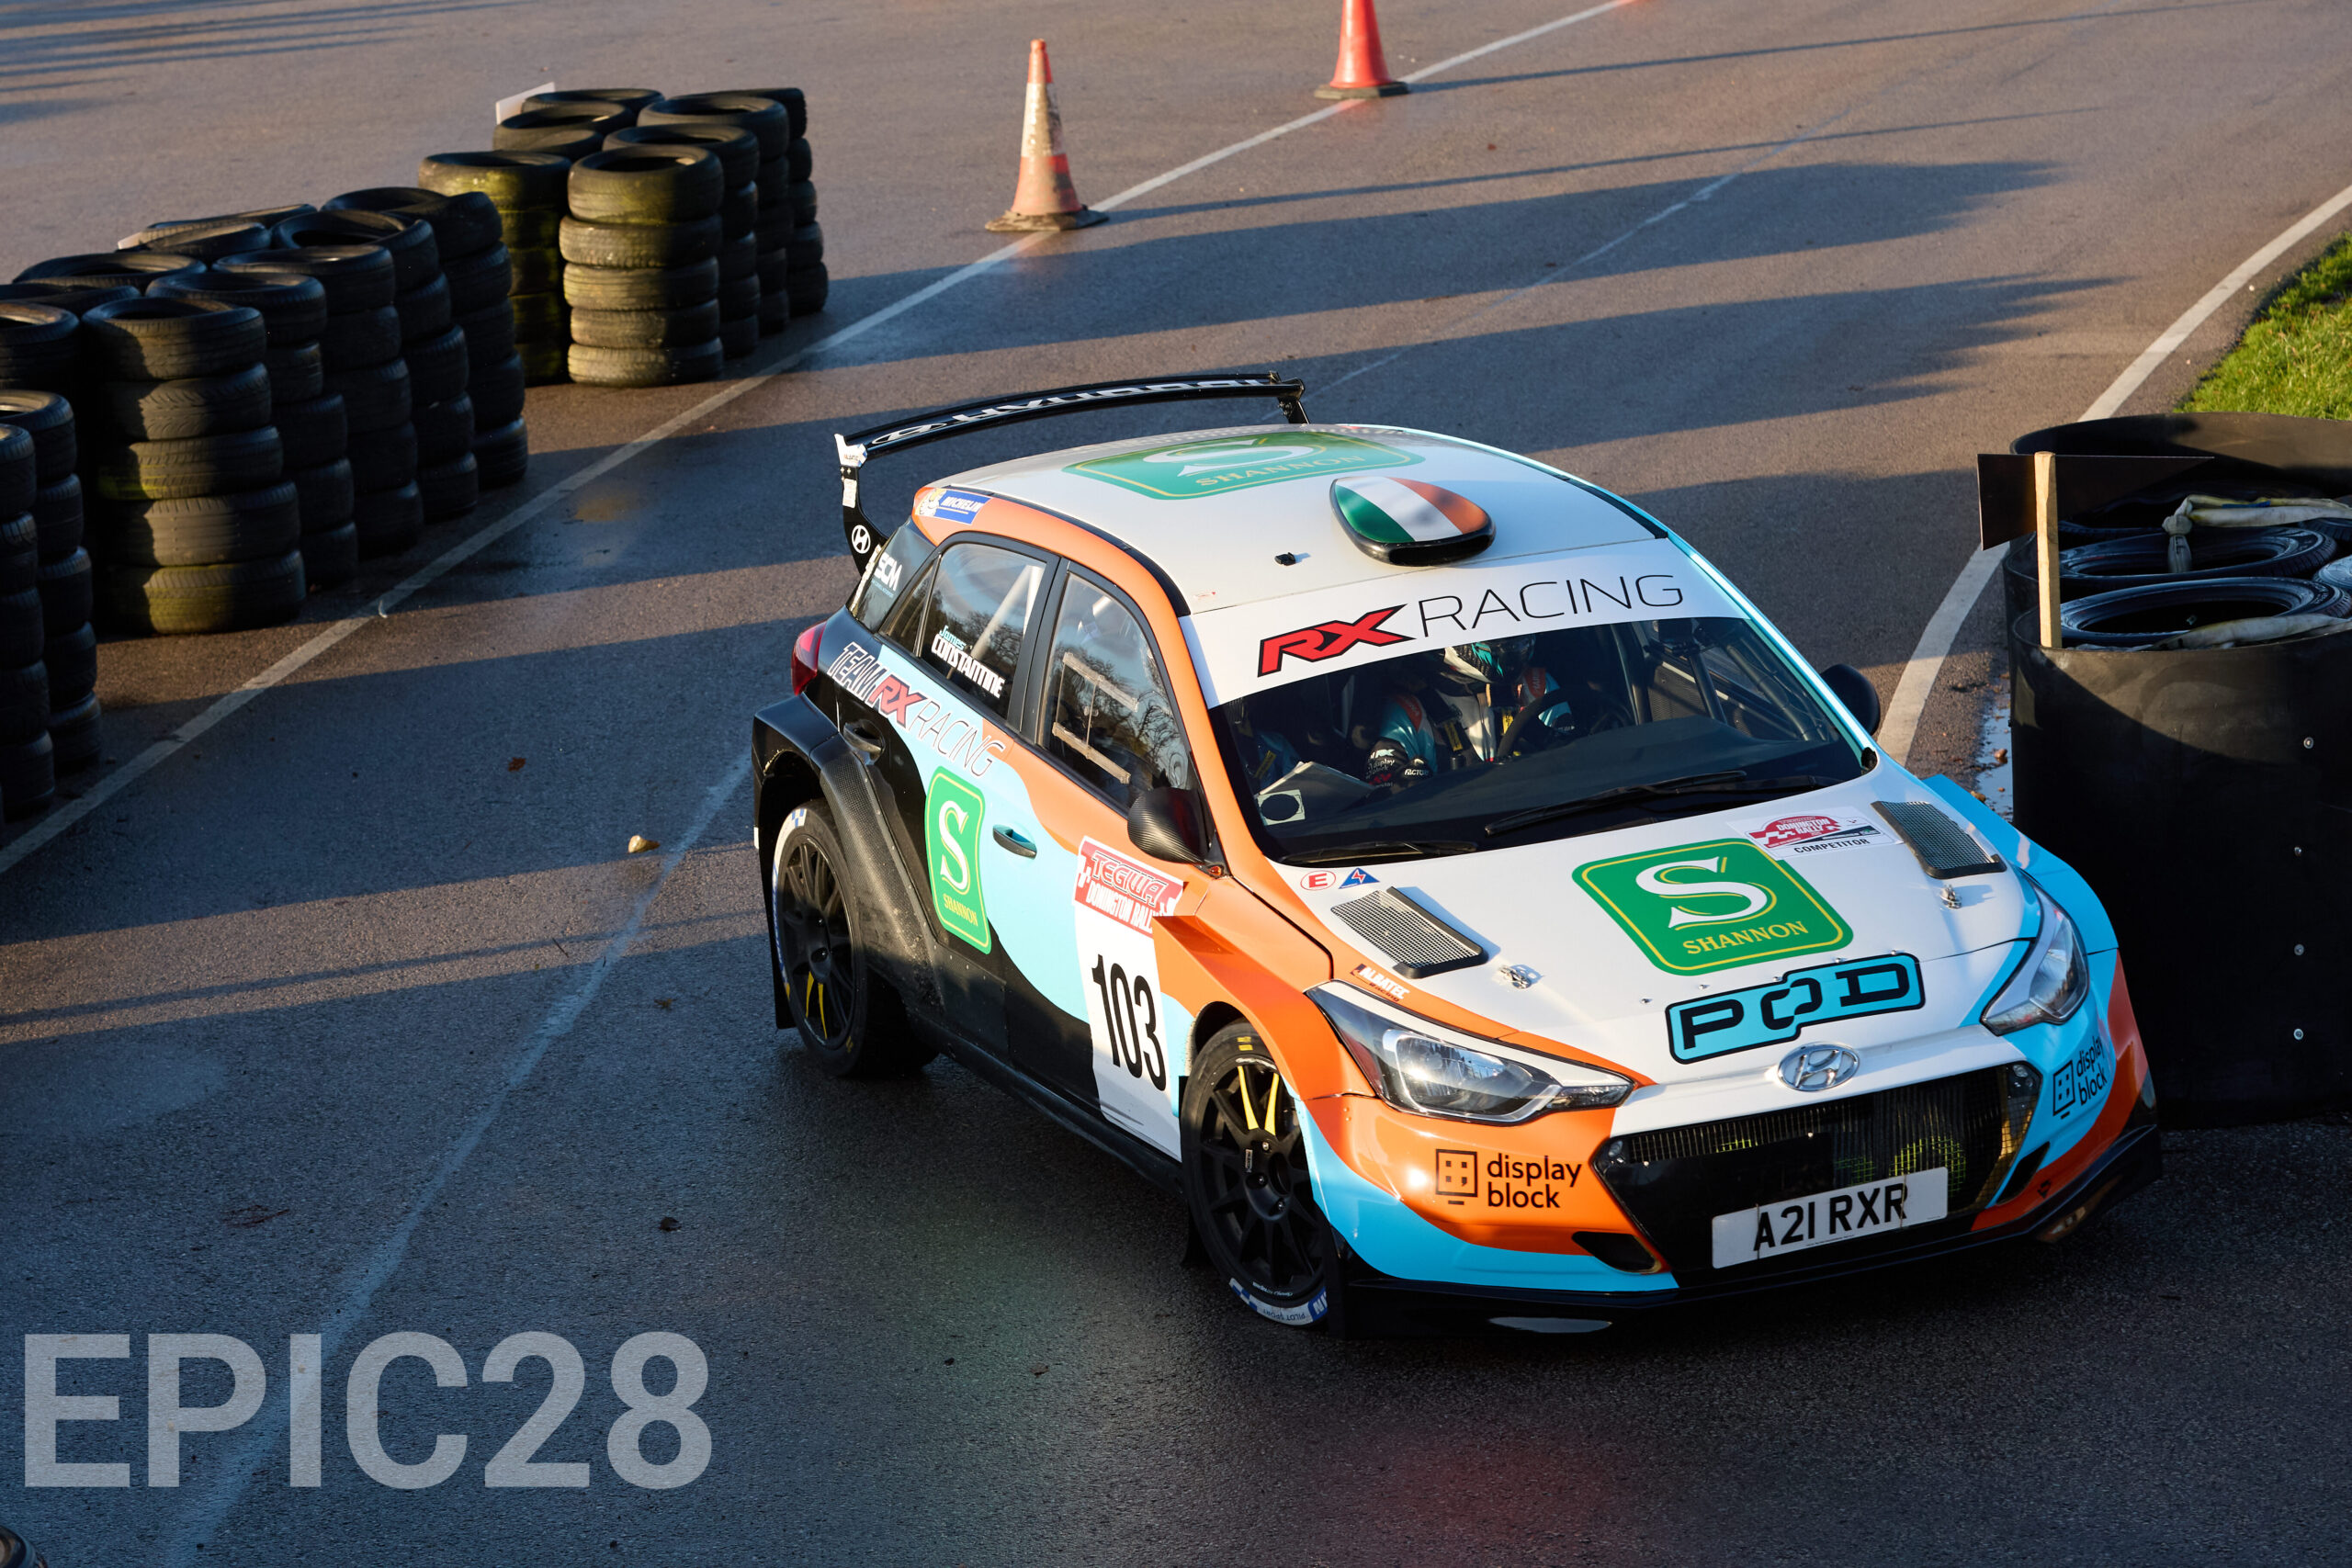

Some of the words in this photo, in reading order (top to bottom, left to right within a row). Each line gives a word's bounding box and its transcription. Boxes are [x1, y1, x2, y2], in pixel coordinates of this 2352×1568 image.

[1195, 455, 1365, 487] SHANNON
[940, 496, 985, 513] MICHELIN
[939, 625, 967, 650] James
[1257, 603, 1419, 679] RX
[1417, 573, 1684, 638] RACING
[932, 634, 1006, 699] CONSTANTINE
[827, 641, 889, 707] TEAM
[868, 674, 927, 729] RX
[908, 701, 1006, 779] RACING
[1775, 818, 1831, 831] DONINGTON
[1795, 825, 1825, 835] RALLY
[1793, 838, 1871, 853] COMPETITOR
[1091, 851, 1168, 907] TEGIWA
[1308, 873, 1329, 888] E
[943, 893, 978, 927] SHANNON
[1086, 881, 1134, 923] DONINGTON
[1130, 904, 1157, 934] RALL
[1682, 920, 1809, 955] SHANNON
[1359, 966, 1410, 999] ALBATEC
[1091, 953, 1167, 1091] 103
[1679, 963, 1909, 1050] POD
[2076, 1035, 2105, 1077] display
[2078, 1062, 2108, 1107] block
[1487, 1152, 1582, 1188] display
[1487, 1180, 1561, 1209] block
[1753, 1201, 1816, 1253] A21
[1829, 1182, 1909, 1236] RXR
[1286, 1312, 1306, 1321] PILOT
